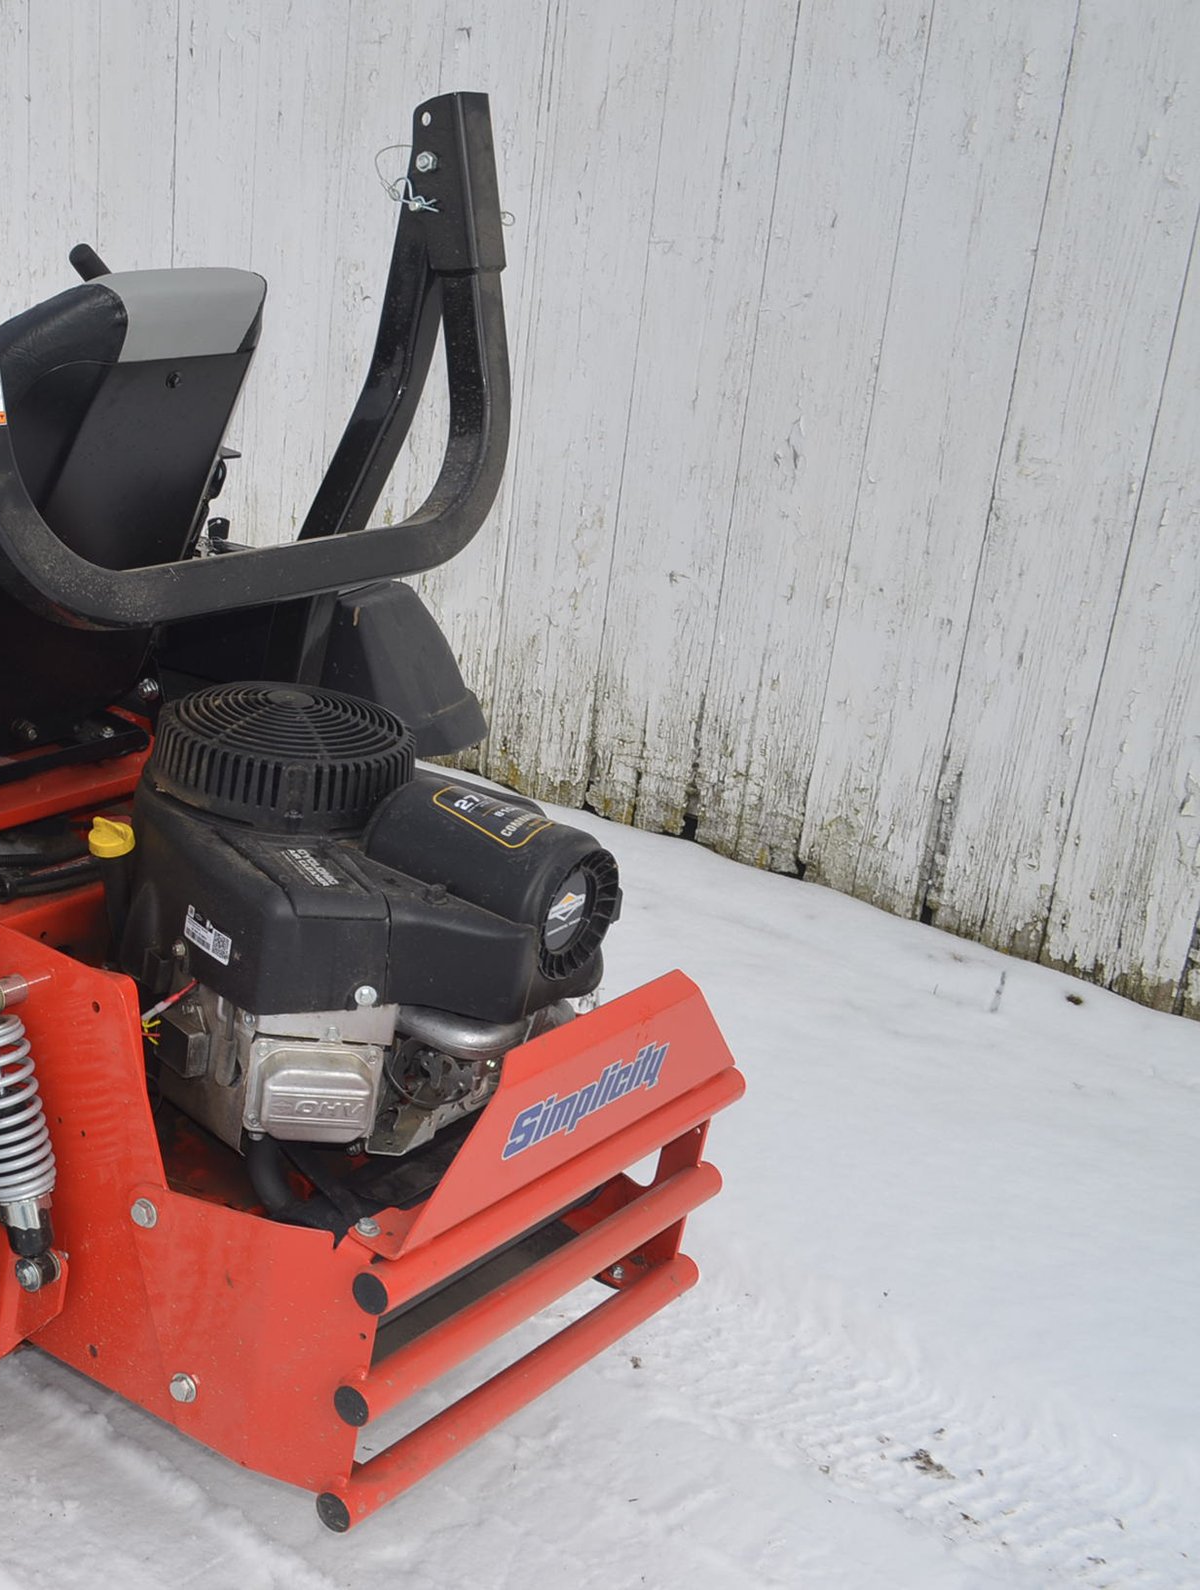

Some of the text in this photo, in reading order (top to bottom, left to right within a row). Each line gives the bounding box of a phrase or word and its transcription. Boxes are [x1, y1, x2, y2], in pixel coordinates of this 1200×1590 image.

[453, 794, 480, 810] 27
[294, 1100, 365, 1117] OHV
[502, 1041, 670, 1161] Simplicity
